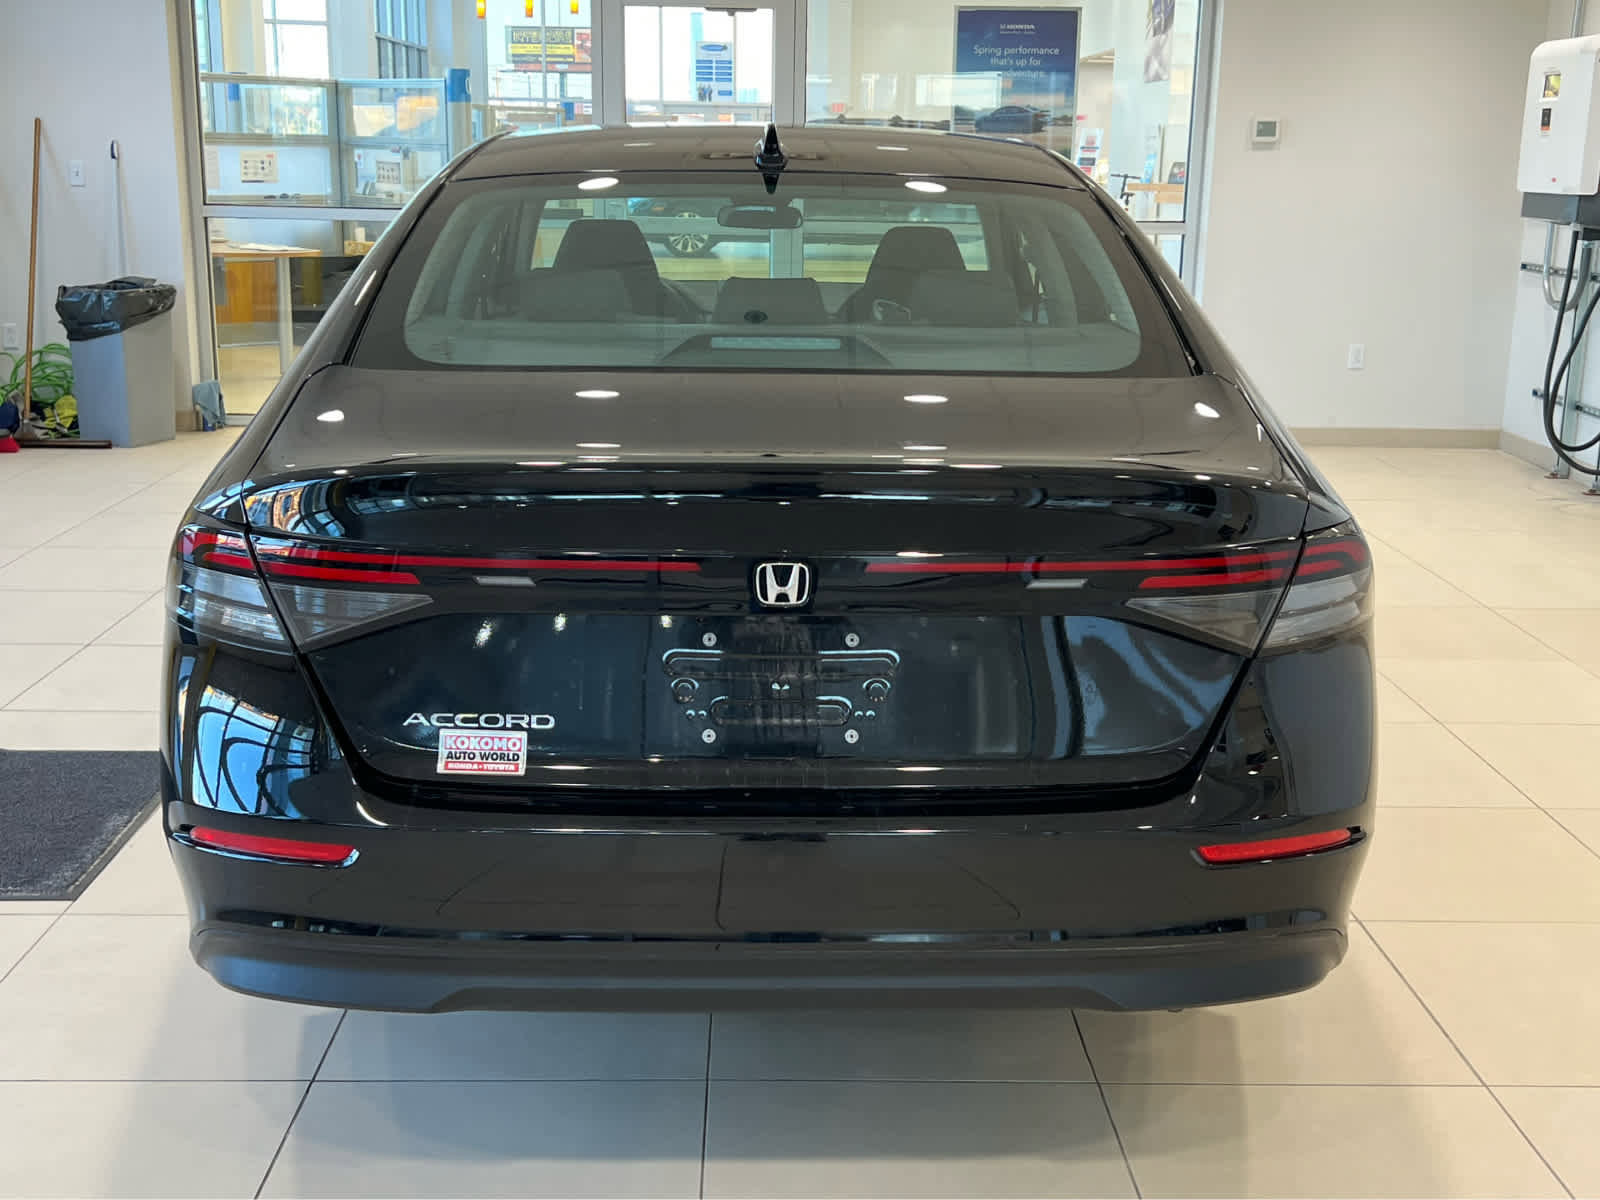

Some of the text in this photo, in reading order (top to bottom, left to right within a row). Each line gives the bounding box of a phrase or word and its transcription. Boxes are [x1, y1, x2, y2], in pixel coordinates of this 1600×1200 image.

[973, 44, 1060, 57] Spring performance
[990, 56, 1041, 66] that's up for
[402, 712, 555, 729] ACCORD
[445, 735, 521, 751] KOKOMO
[446, 751, 520, 762] AUTO WORLD
